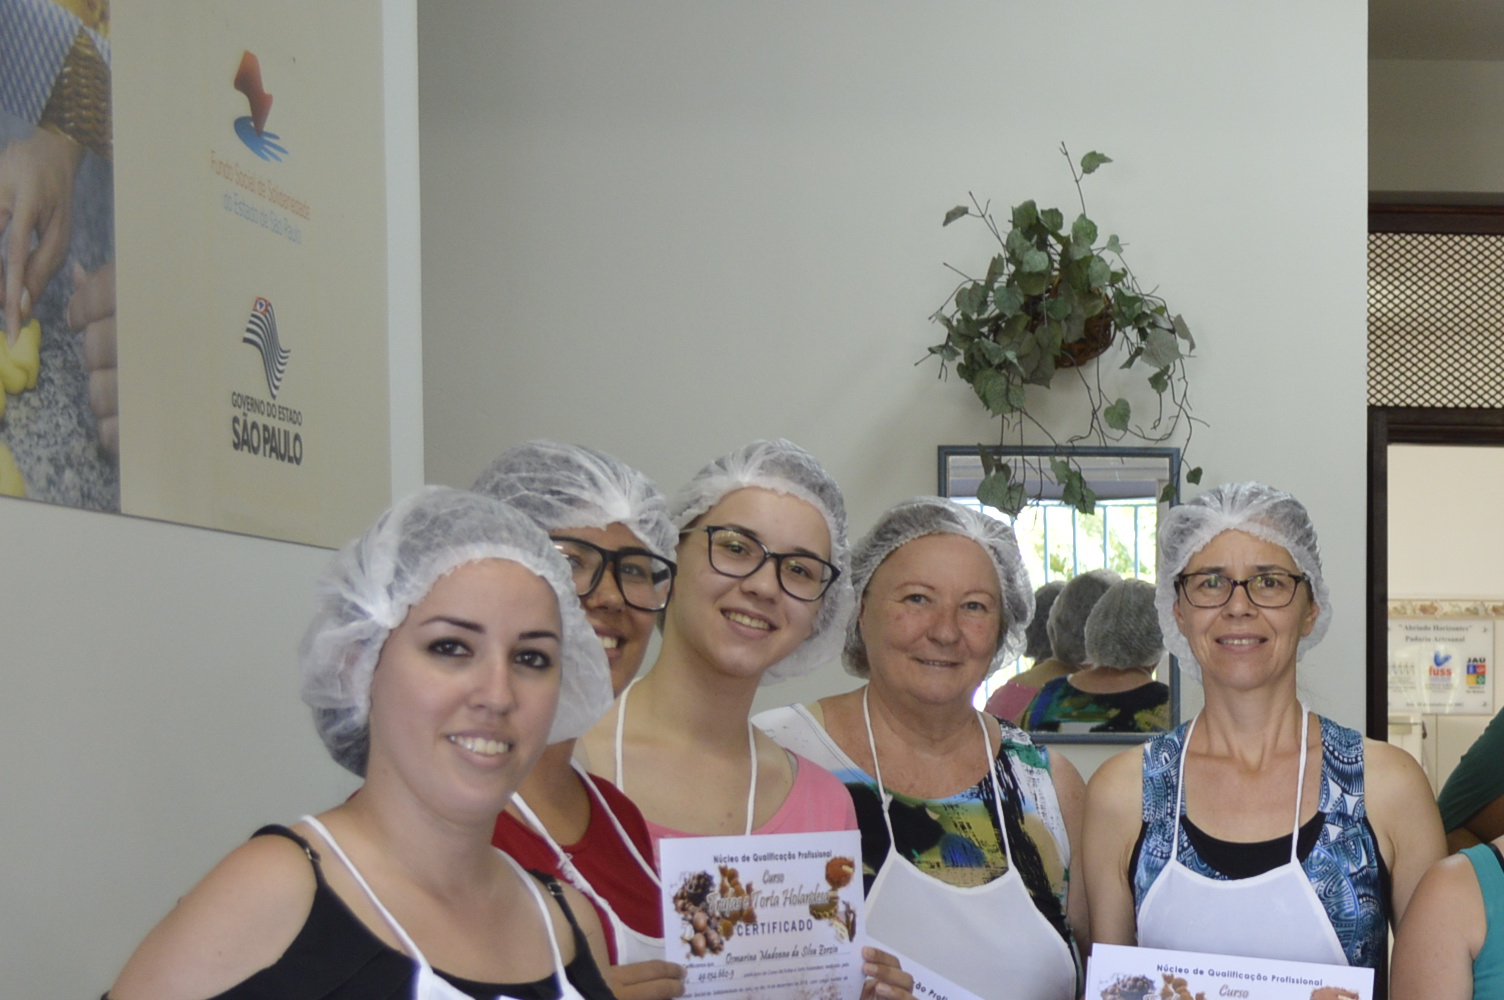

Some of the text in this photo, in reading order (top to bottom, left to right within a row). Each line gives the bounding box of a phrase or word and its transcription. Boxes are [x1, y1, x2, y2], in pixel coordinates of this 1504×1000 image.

[232, 391, 303, 426] GOVERNO DO ESTADO
[232, 413, 303, 466] SÃO PAULO
[1428, 665, 1453, 677] fuss
[713, 853, 739, 866] Núcleo
[740, 852, 750, 864] de
[752, 849, 796, 865] Qualificação
[762, 868, 785, 886] Curso
[752, 886, 780, 912] Torta
[736, 916, 813, 939] CERTIFICADO
[1156, 963, 1323, 987] Núcleo de Qualificação Profissional
[1218, 983, 1250, 999] Curso
